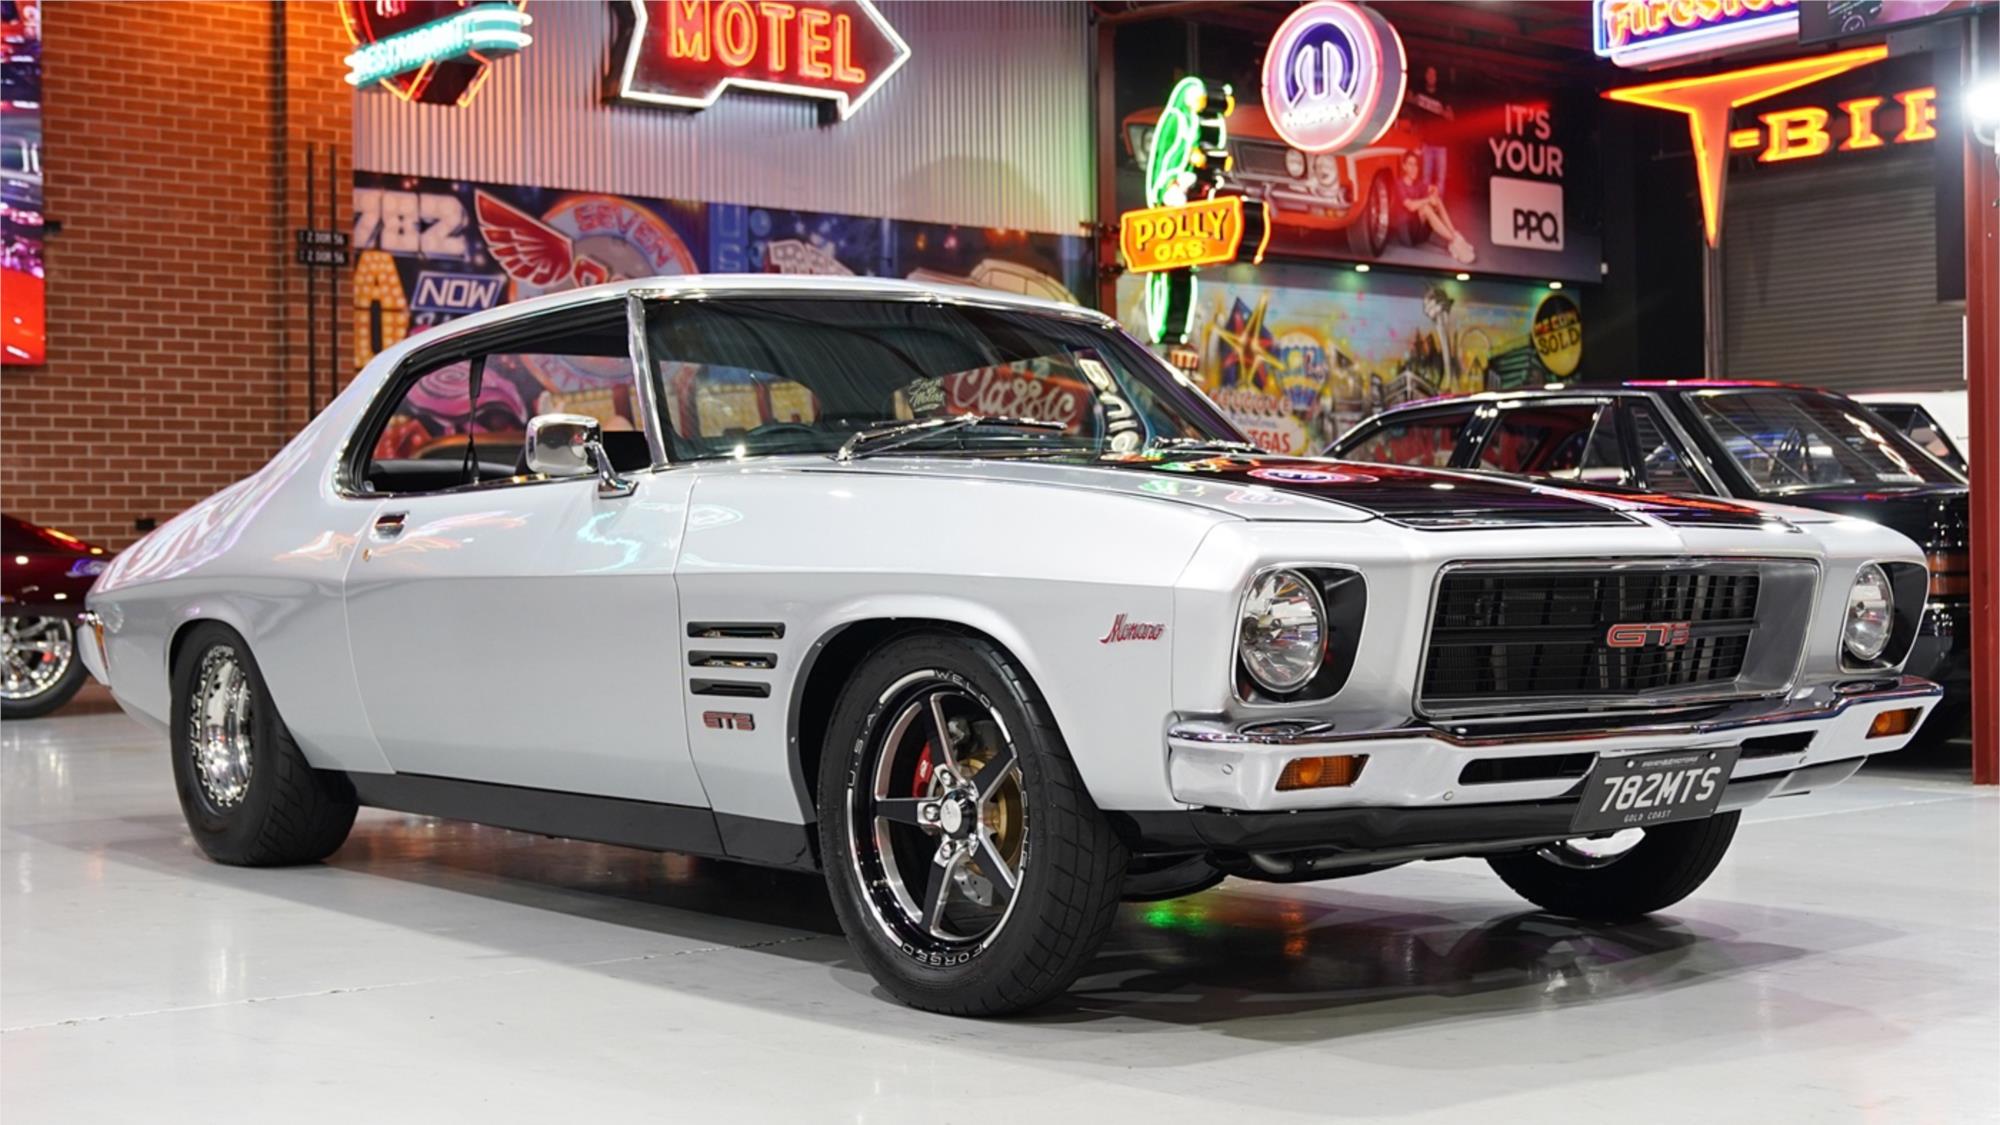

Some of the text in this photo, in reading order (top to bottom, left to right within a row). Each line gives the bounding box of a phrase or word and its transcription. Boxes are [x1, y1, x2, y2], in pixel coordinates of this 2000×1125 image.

[667, 0, 867, 84] MOTEL
[1505, 103, 1552, 141] IT'S
[1489, 136, 1564, 178] YOUR
[353, 188, 468, 258] 782
[573, 203, 678, 269] SEVEN
[1133, 208, 1228, 250] POLLY
[1513, 207, 1560, 244] PPQ
[1154, 240, 1204, 262] GAS
[418, 277, 497, 309] NOW
[1538, 326, 1580, 356] SOLD
[1606, 620, 1692, 648] GTS
[935, 669, 991, 709] WELD
[703, 710, 755, 731] GTS
[1600, 766, 1722, 813] 782MTS
[1623, 809, 1673, 824] GOLD COAST
[901, 942, 984, 966] FORGED
